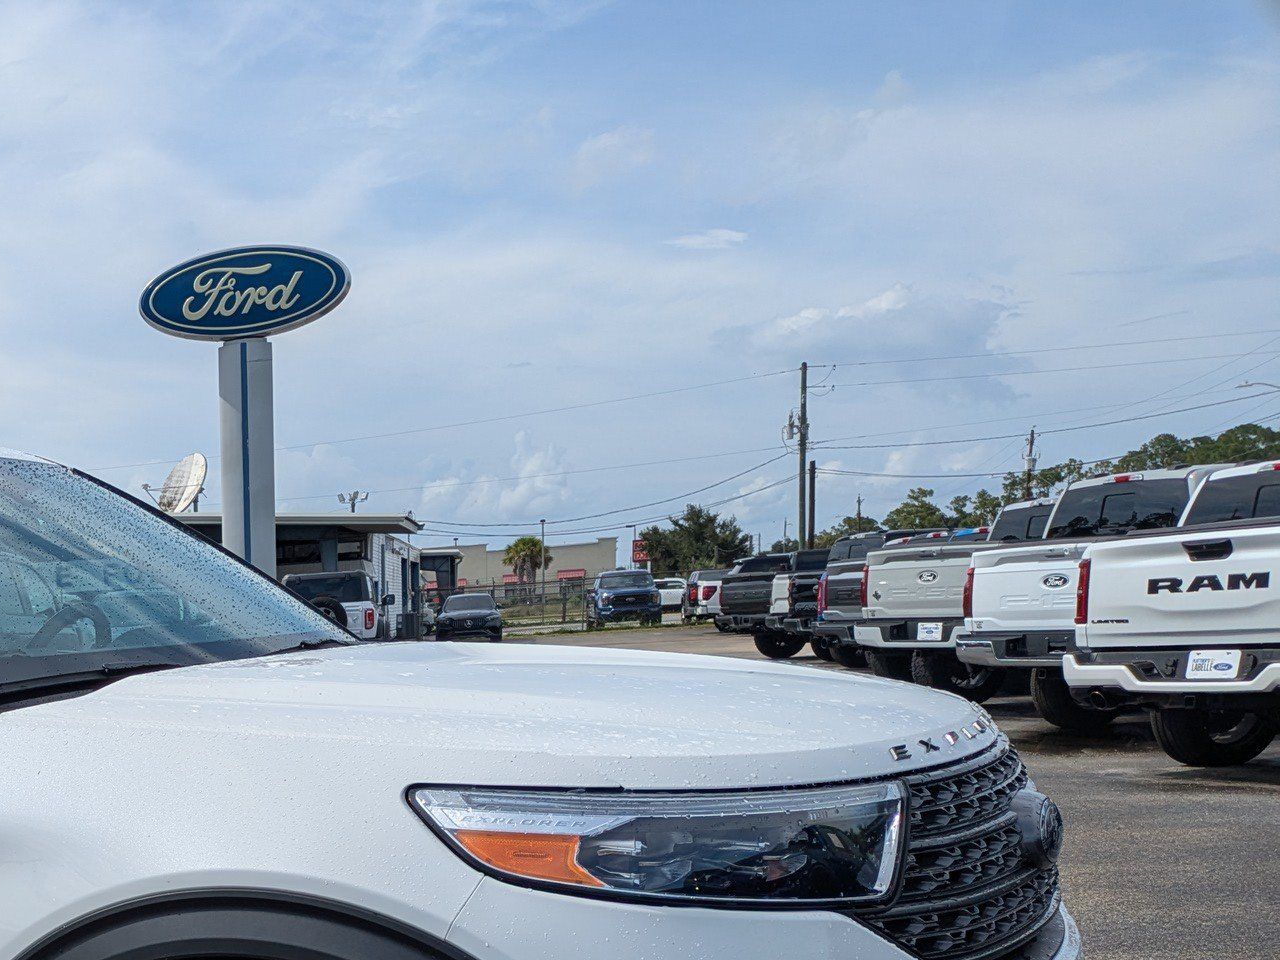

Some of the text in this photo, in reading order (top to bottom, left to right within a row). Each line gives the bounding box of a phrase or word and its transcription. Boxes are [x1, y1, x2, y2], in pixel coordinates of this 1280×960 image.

[182, 262, 303, 321] Ford
[1146, 571, 1271, 595] RAM
[461, 815, 588, 828] EXPLORER
